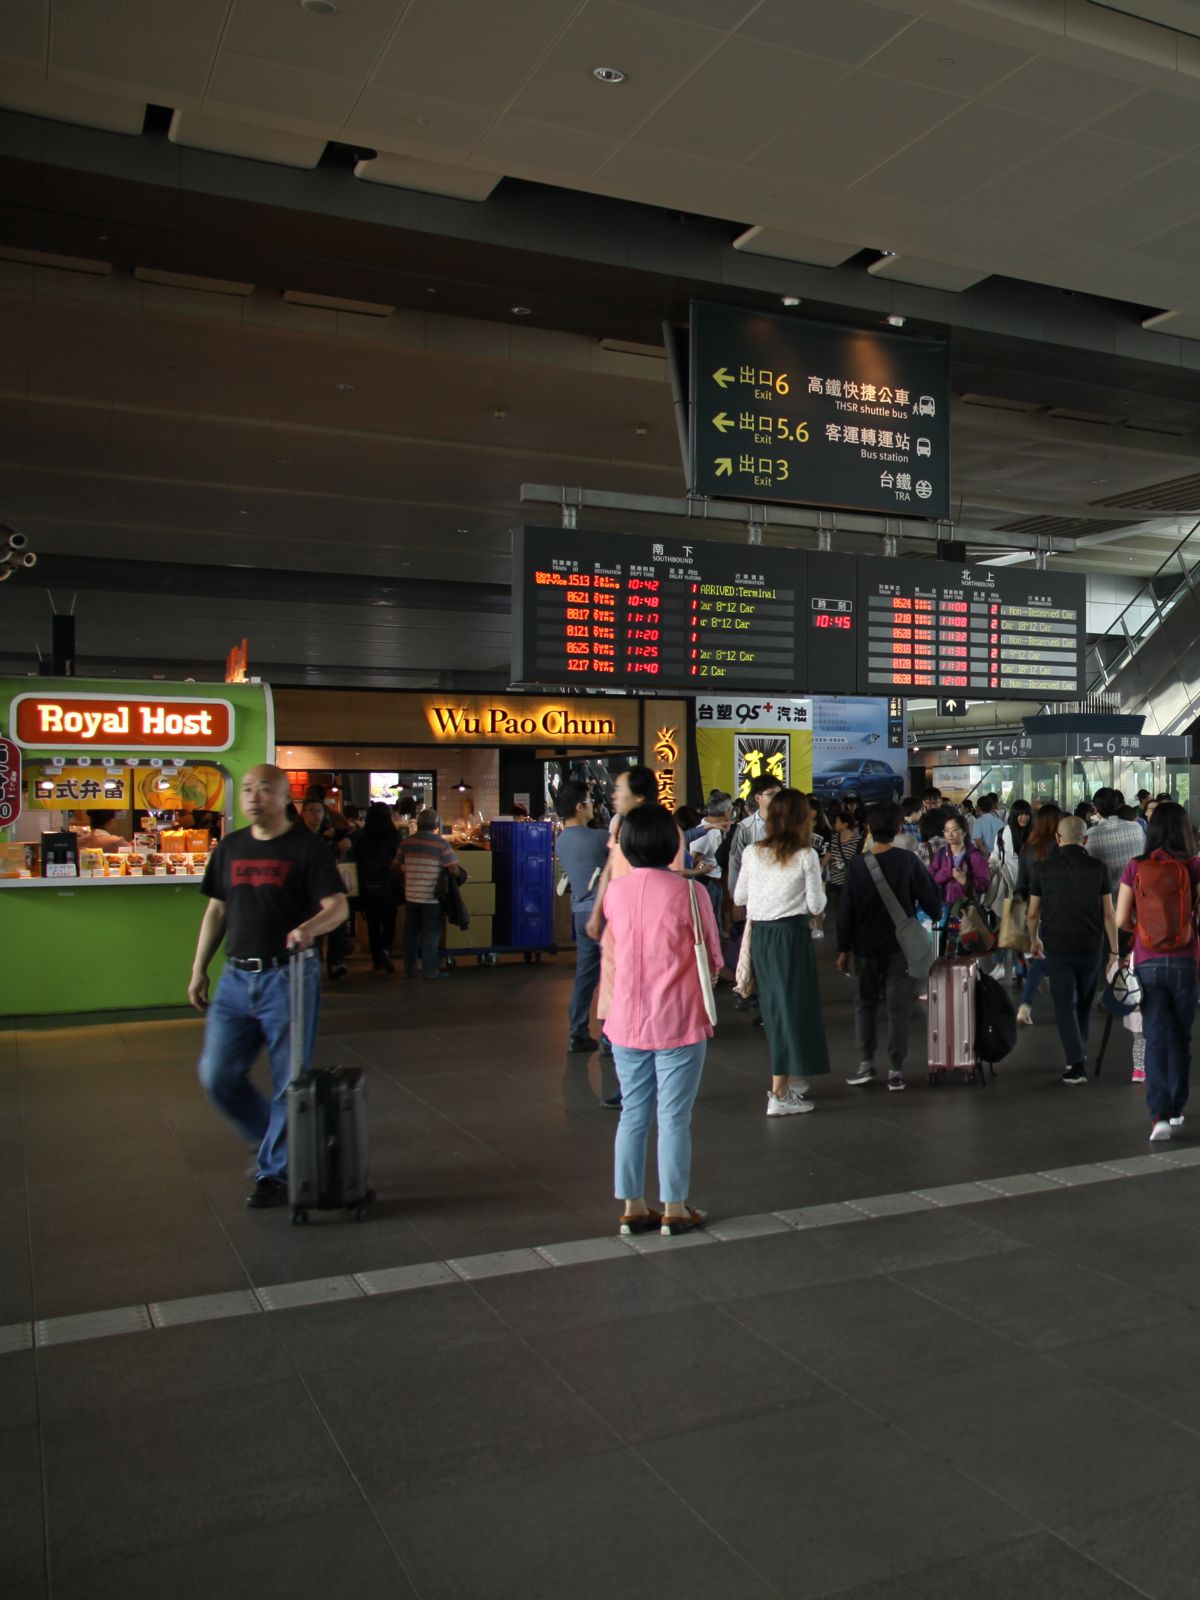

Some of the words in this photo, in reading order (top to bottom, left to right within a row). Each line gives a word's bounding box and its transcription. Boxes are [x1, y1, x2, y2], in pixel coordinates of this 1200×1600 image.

[754, 389, 773, 400] Exit
[808, 375, 910, 407] 高鐵快捷公車
[835, 401, 858, 413] THSR
[860, 404, 890, 417] shuttle
[892, 408, 908, 420] bus
[754, 434, 772, 445] Exit
[825, 423, 911, 451] 客運轉運站
[860, 449, 877, 460] Bus
[879, 451, 909, 463] station
[754, 476, 772, 487] Exit
[879, 470, 912, 491] 台鐵
[895, 491, 911, 501] TRA
[652, 555, 694, 564] SOUTHBOUND
[569, 574, 590, 586] 1513
[962, 569, 994, 582] 北上
[628, 579, 659, 591] 10:42
[692, 584, 697, 593] 1
[961, 580, 995, 588] NORTHBOUND
[628, 596, 659, 608] 10:48
[740, 603, 755, 613] Car
[991, 604, 998, 615] 2
[628, 613, 659, 624] 11:17
[735, 619, 751, 629] Car
[816, 615, 851, 629] 10:45
[991, 619, 998, 629] 2
[628, 630, 659, 640] 11:20
[991, 634, 998, 644] 2
[627, 646, 659, 657] 11:25
[740, 651, 755, 661] Car
[991, 648, 998, 659] 2
[567, 659, 590, 671] 1217
[627, 663, 659, 674] 11:40
[991, 663, 998, 673] 2
[711, 666, 726, 676] Car
[991, 678, 998, 688] 2
[37, 704, 129, 737] Royal
[139, 707, 212, 735] Host
[431, 707, 482, 734] Wu
[488, 709, 537, 735] Pao
[542, 711, 615, 735] Chun
[998, 740, 1018, 756] 1-6
[1083, 737, 1116, 753] 1-6
[1120, 736, 1139, 748] 車廂
[1121, 748, 1131, 756] Car
